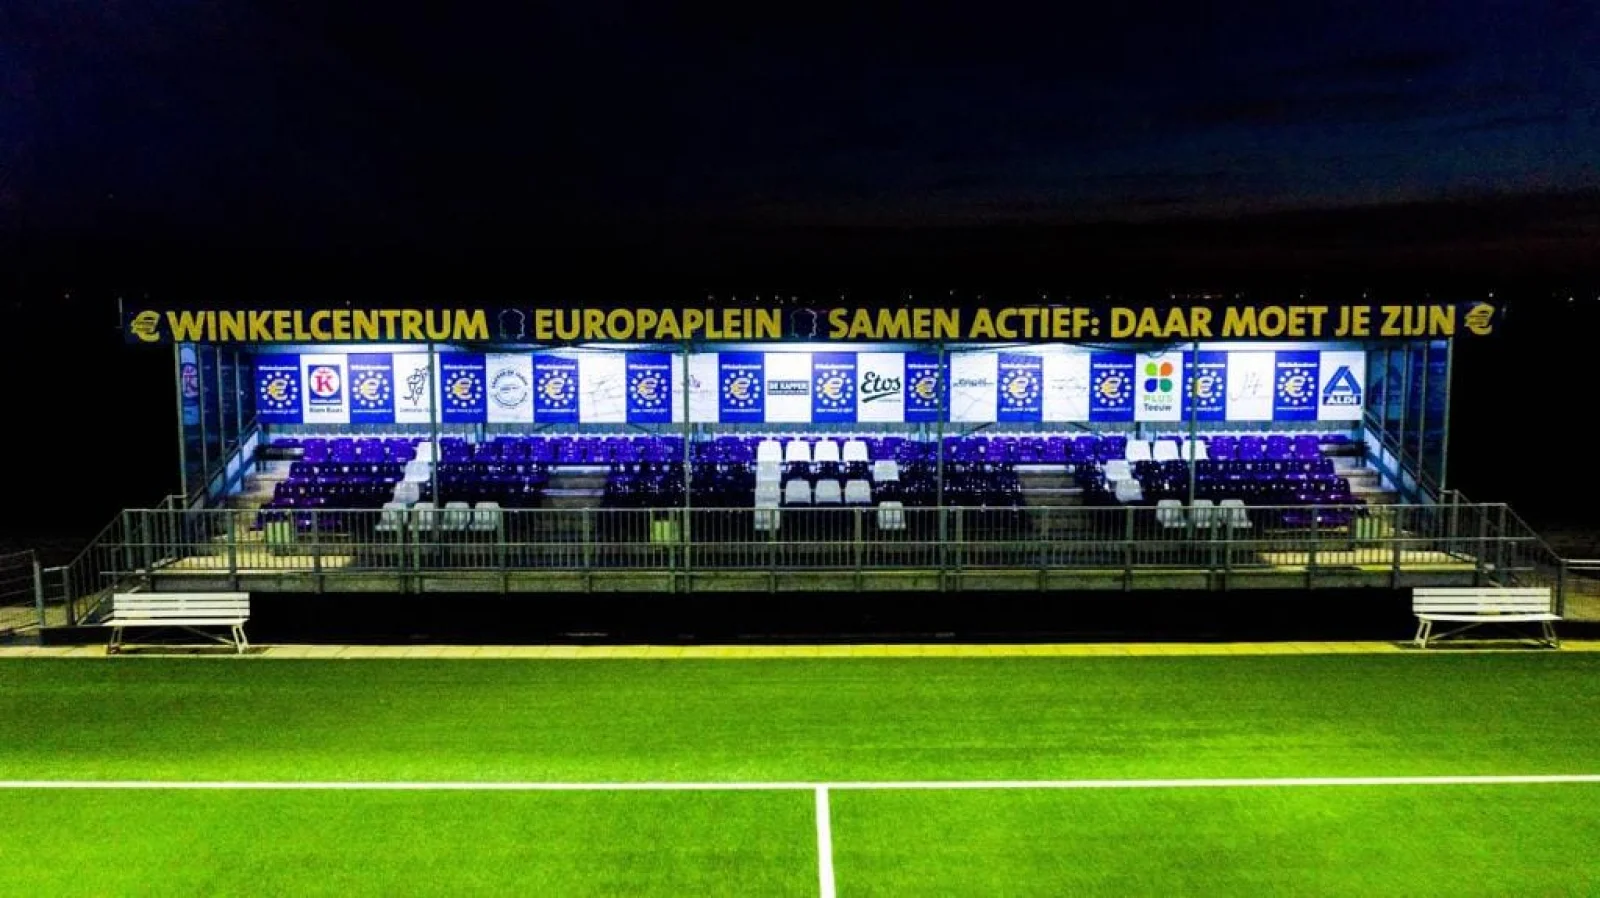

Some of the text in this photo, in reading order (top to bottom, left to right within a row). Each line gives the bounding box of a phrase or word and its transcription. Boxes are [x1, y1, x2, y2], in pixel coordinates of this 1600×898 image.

[167, 309, 489, 341] WINKELCENTRUM
[535, 308, 781, 340] EUROPAPLEIN
[829, 308, 959, 339] SAMEN
[969, 308, 1099, 338] ACTIEF:
[1110, 307, 1212, 338] DAAR
[1221, 306, 1328, 337] MOET
[1335, 306, 1371, 336] JE
[1380, 305, 1456, 336] ZIJN
[861, 371, 901, 393] Etos
[1326, 395, 1357, 404] ALDI
